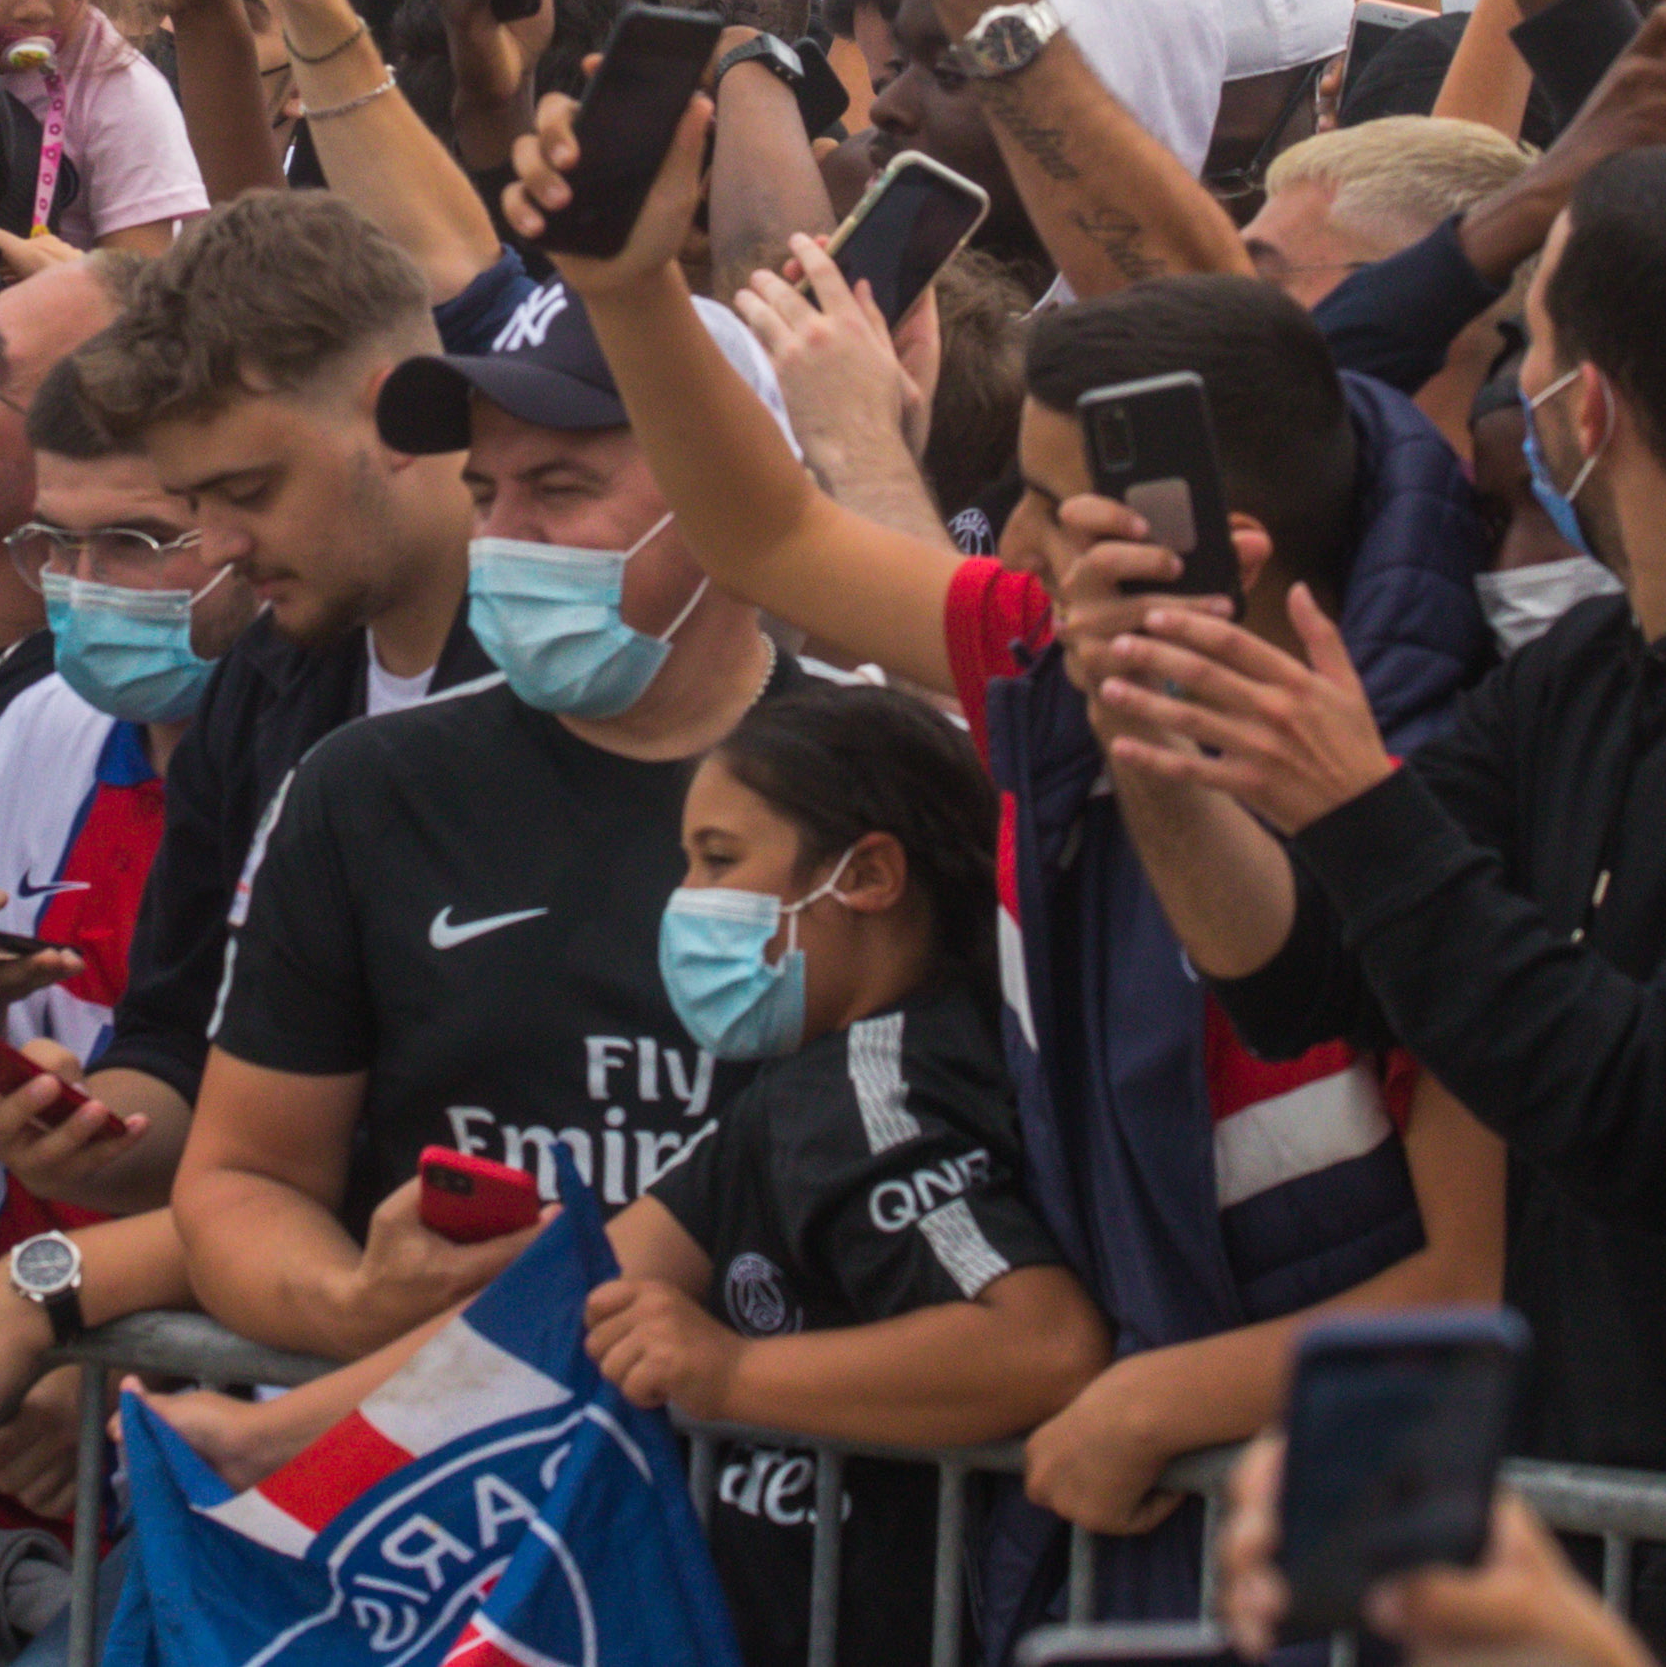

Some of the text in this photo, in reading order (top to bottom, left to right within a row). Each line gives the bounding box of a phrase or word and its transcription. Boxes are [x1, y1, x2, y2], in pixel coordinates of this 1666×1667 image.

[491, 282, 568, 352] NY
[583, 1034, 716, 1117] Fly
[445, 1105, 685, 1205] Emir
